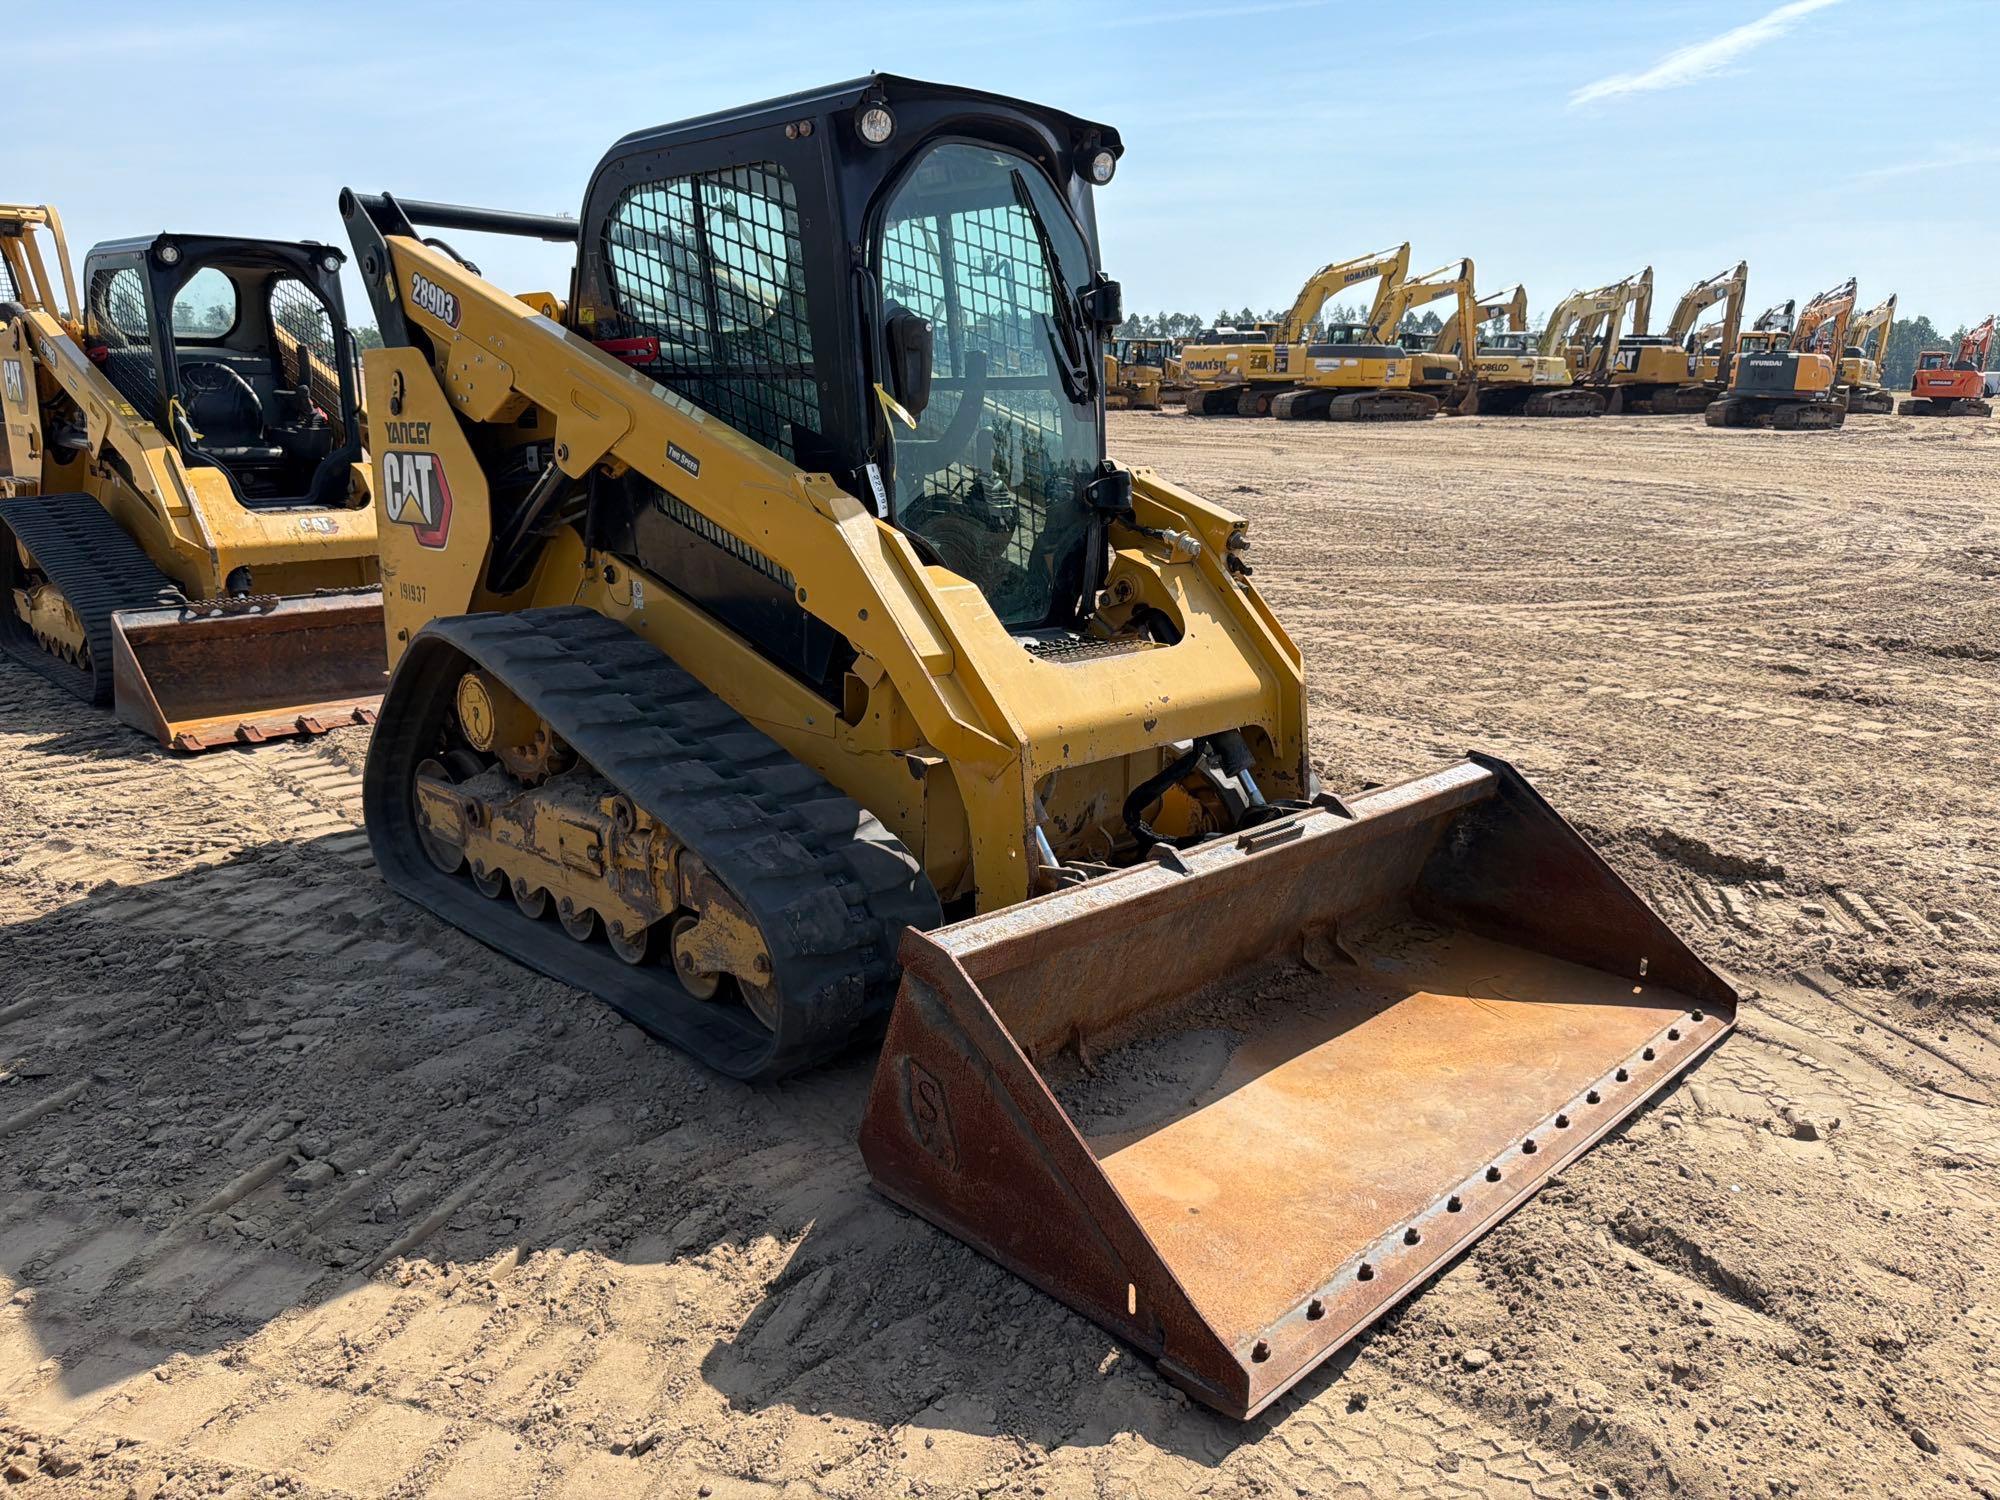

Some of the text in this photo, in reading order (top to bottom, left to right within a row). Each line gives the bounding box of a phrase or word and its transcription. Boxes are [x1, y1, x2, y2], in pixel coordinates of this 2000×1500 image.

[1344, 266, 1379, 283] KOMATSU
[411, 272, 454, 325] 289D3
[1185, 357, 1227, 370] KOMATSU
[1612, 351, 1636, 371] AT
[3, 360, 24, 401] CAT
[384, 422, 431, 445] YANCEY
[680, 454, 698, 472] SPEED
[383, 452, 433, 525] CAT
[300, 517, 330, 532] CAT
